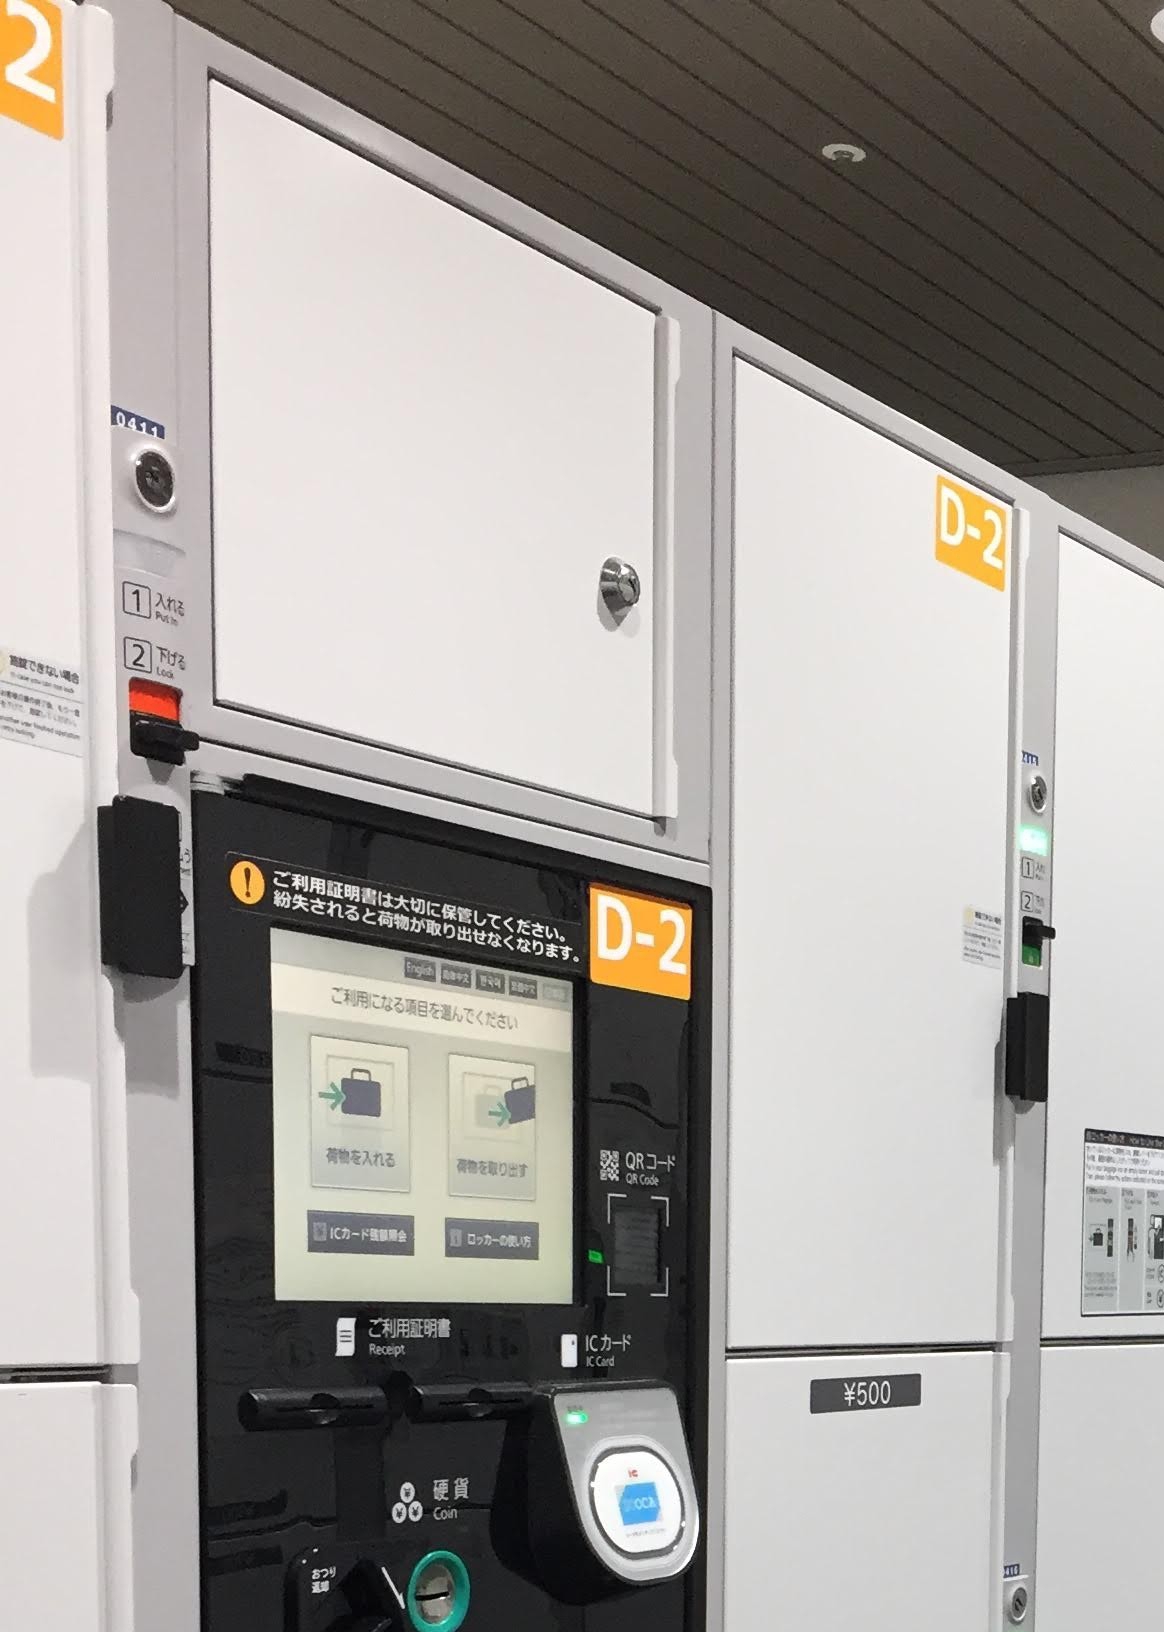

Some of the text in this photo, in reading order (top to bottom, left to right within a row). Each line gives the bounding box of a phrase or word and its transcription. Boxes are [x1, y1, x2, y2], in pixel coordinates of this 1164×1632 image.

[116, 411, 159, 437] 0411
[940, 488, 1003, 571] D-2
[132, 589, 185, 616] 1 入れる
[132, 644, 187, 669] 2 下げる
[273, 869, 567, 944] ご利用証明書は大切に保管してください。
[273, 890, 581, 963] 紛失されると荷物が取り出せなくなります。
[596, 892, 688, 976] D-2
[406, 961, 434, 977] English
[331, 985, 519, 1031] ご利用になる項目を選んでください
[326, 1147, 397, 1168] 荷物を入れる
[456, 1158, 529, 1179] 荷物を取り出す
[626, 1174, 660, 1187] QR Code
[369, 1317, 452, 1339] ご利用証明書
[369, 1343, 407, 1358] Receipt
[595, 1356, 615, 1368] Card
[843, 1380, 892, 1407] ¥500
[433, 1477, 470, 1501] 硬貨
[433, 1506, 458, 1521] Coin
[311, 1566, 338, 1580] おつり
